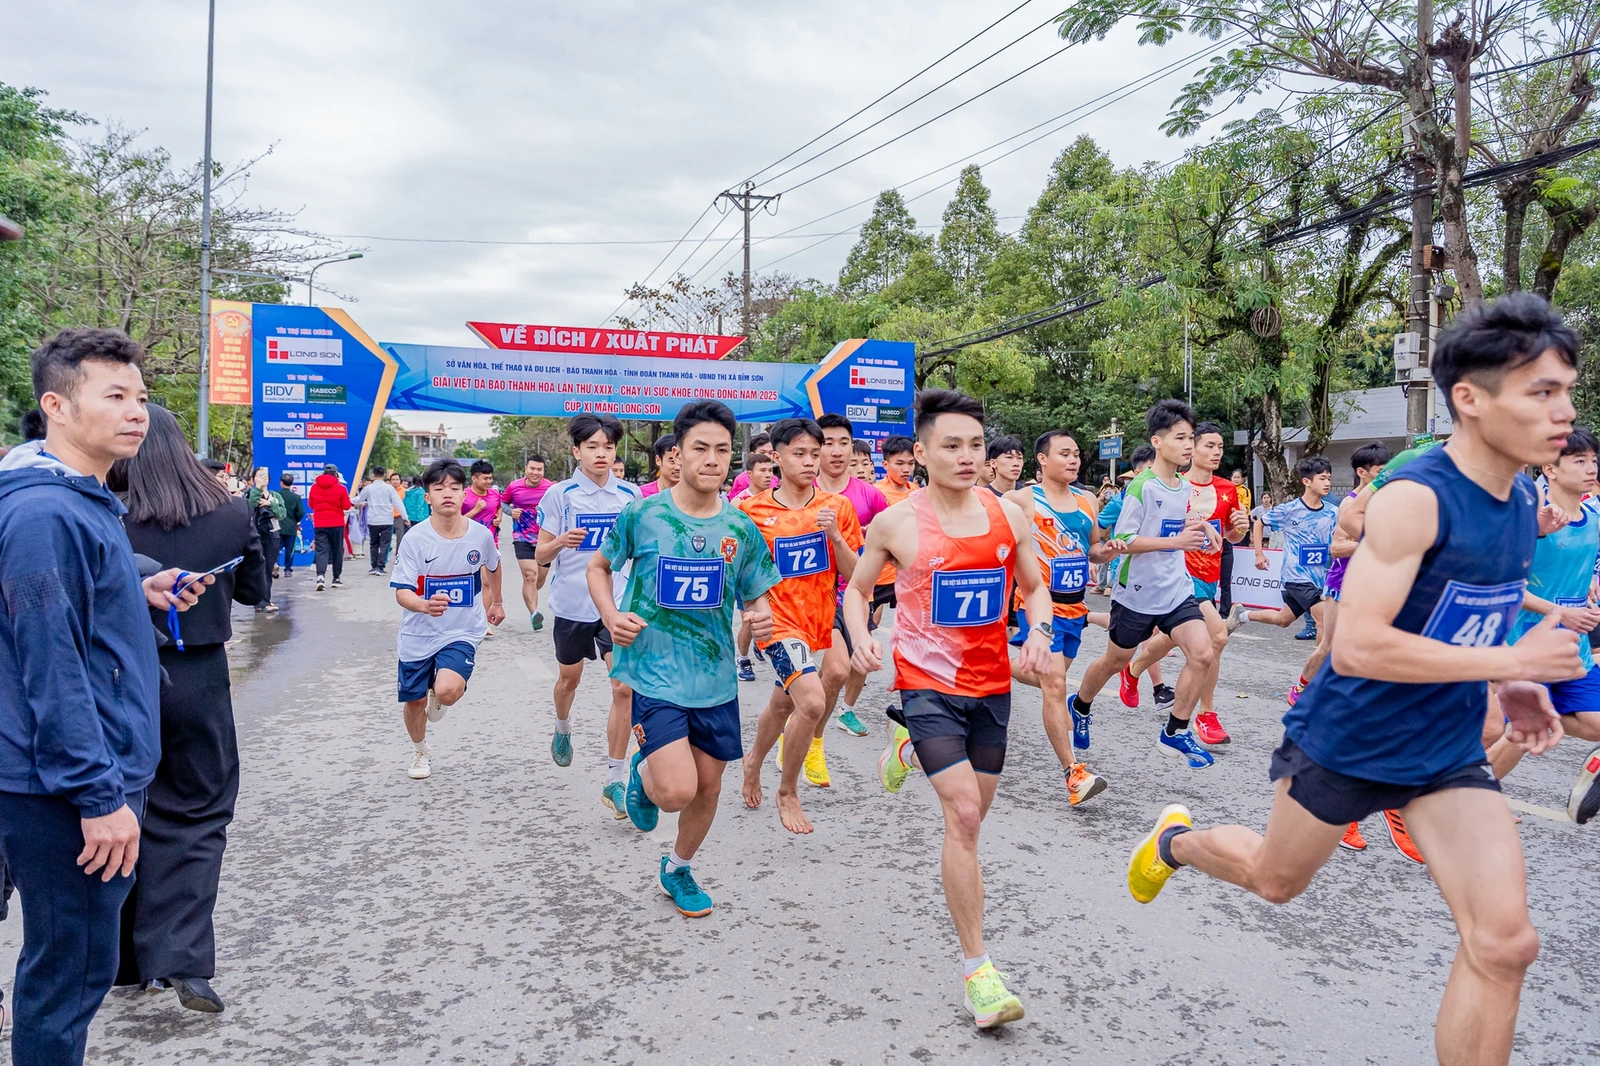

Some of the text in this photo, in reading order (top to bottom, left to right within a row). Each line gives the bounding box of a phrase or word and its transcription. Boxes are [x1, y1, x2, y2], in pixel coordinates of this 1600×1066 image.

[500, 326, 718, 354] VỀ ĐÍCH / XUẤT PHÁT
[446, 359, 455, 368] SỞ
[265, 386, 294, 396] BIDV
[433, 374, 450, 387] GIẢI
[453, 376, 471, 390] VIỆT
[508, 380, 535, 391] THANH
[576, 383, 592, 394] THỨ
[594, 385, 612, 394] XXIX
[620, 386, 641, 398] CHẠY
[759, 391, 777, 400] 2025
[565, 399, 581, 411] CÚP
[584, 402, 592, 411] XI
[621, 403, 642, 413] LONG
[644, 403, 660, 414] SƠN
[848, 407, 868, 416] BIDV
[788, 548, 817, 571] 72
[1307, 552, 1322, 564] 23
[674, 576, 708, 602] 75
[1061, 569, 1083, 588] 45
[955, 590, 988, 618] 71
[1450, 612, 1502, 646] 48
[791, 642, 807, 664] 7
